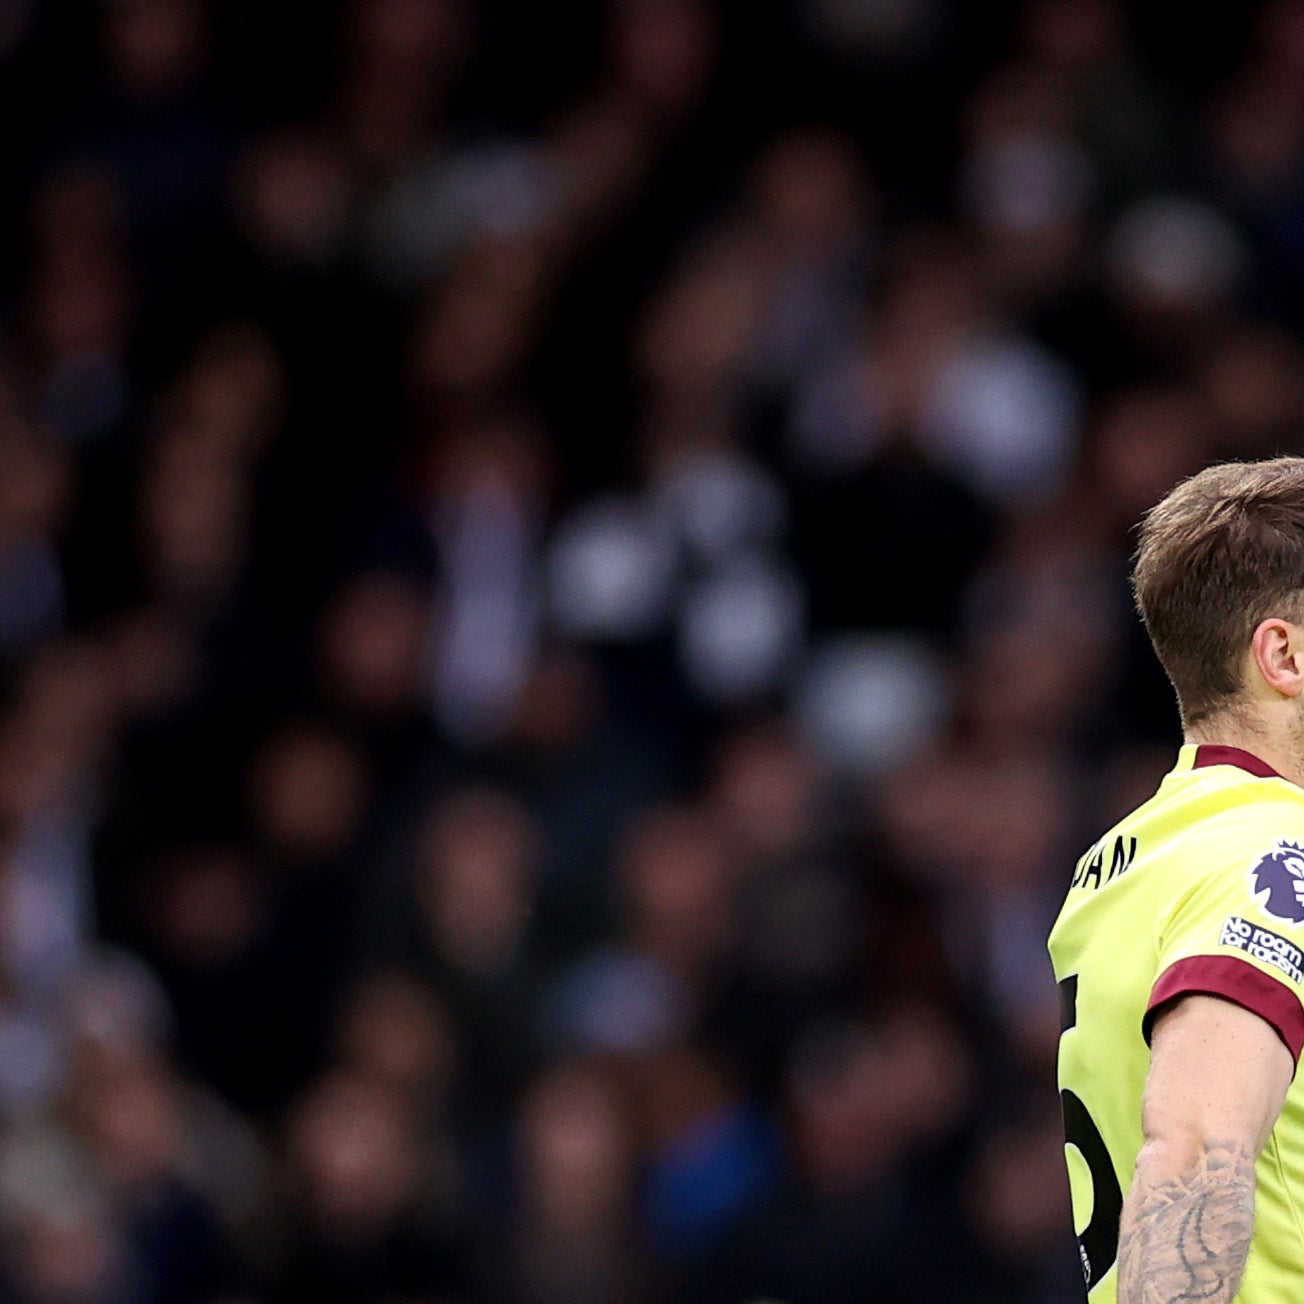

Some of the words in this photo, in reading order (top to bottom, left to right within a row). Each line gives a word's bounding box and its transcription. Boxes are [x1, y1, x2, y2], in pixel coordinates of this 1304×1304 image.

[1219, 931, 1248, 948] for
[1247, 942, 1303, 985] racism
[1222, 917, 1251, 938] No
[1252, 929, 1302, 967] room
